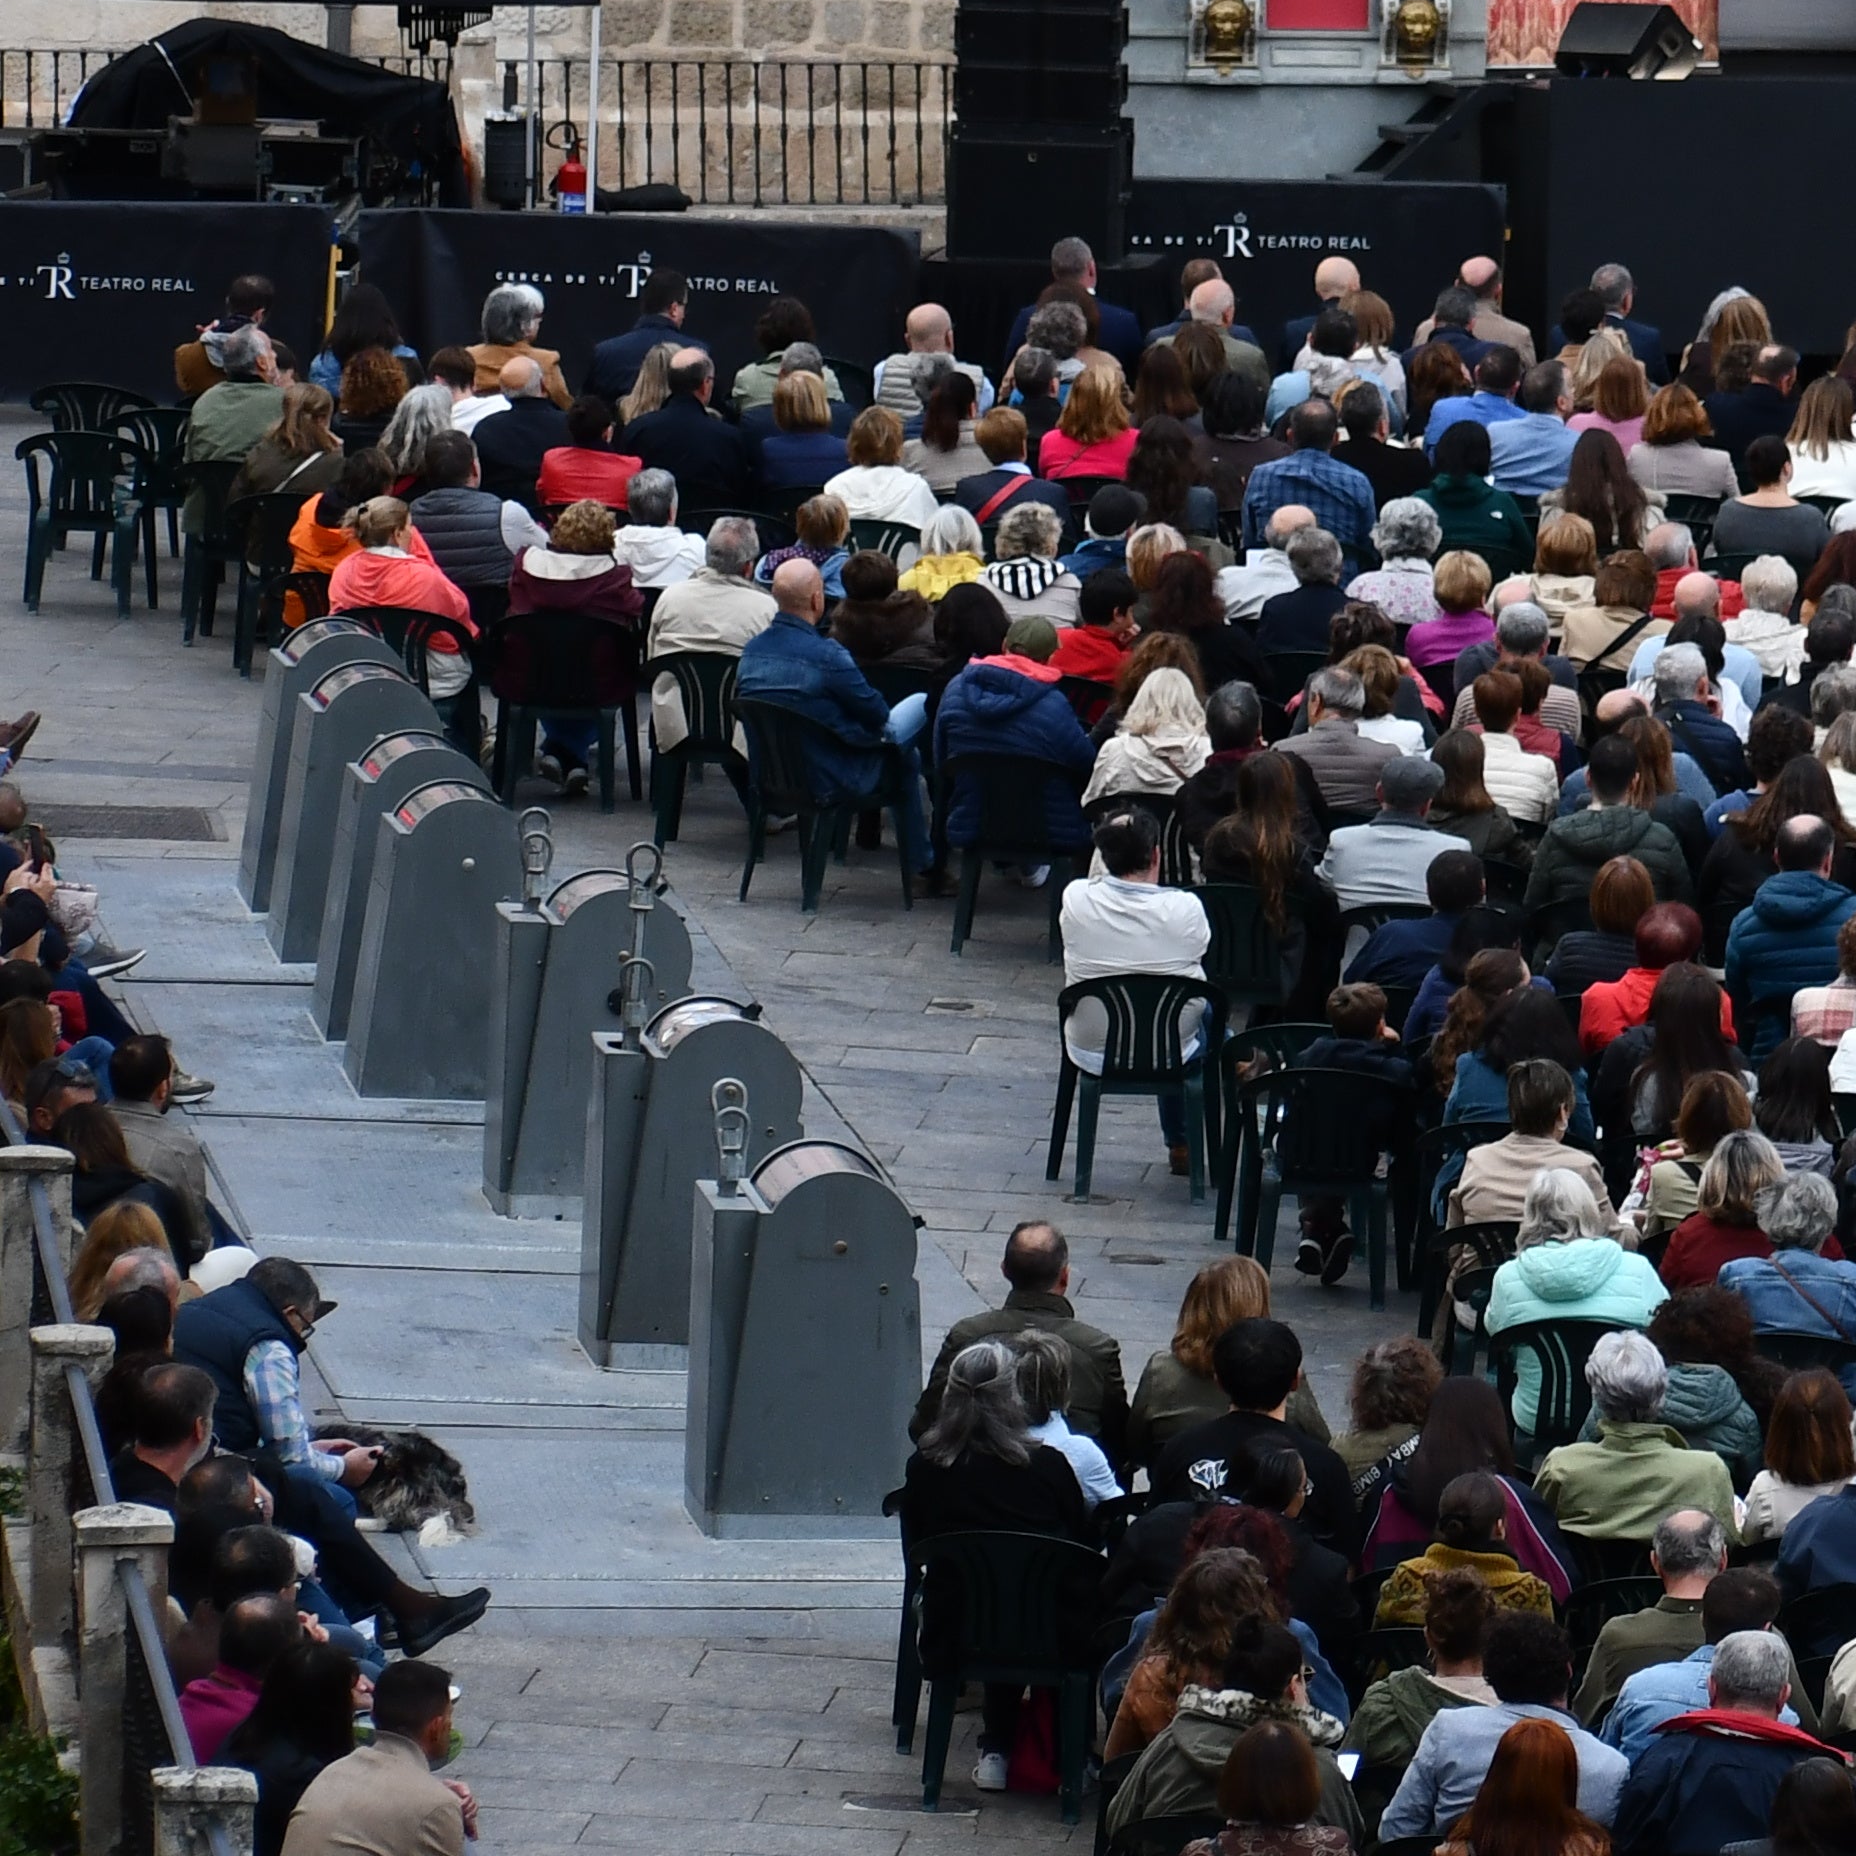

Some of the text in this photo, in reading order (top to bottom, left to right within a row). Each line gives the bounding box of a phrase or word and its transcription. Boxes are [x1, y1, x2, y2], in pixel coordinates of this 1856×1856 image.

[1257, 235, 1323, 249] TEATRO
[1328, 236, 1372, 250] REAL
[80, 276, 146, 292] TEATRO
[151, 278, 196, 293] REAL
[735, 279, 781, 294] REAL
